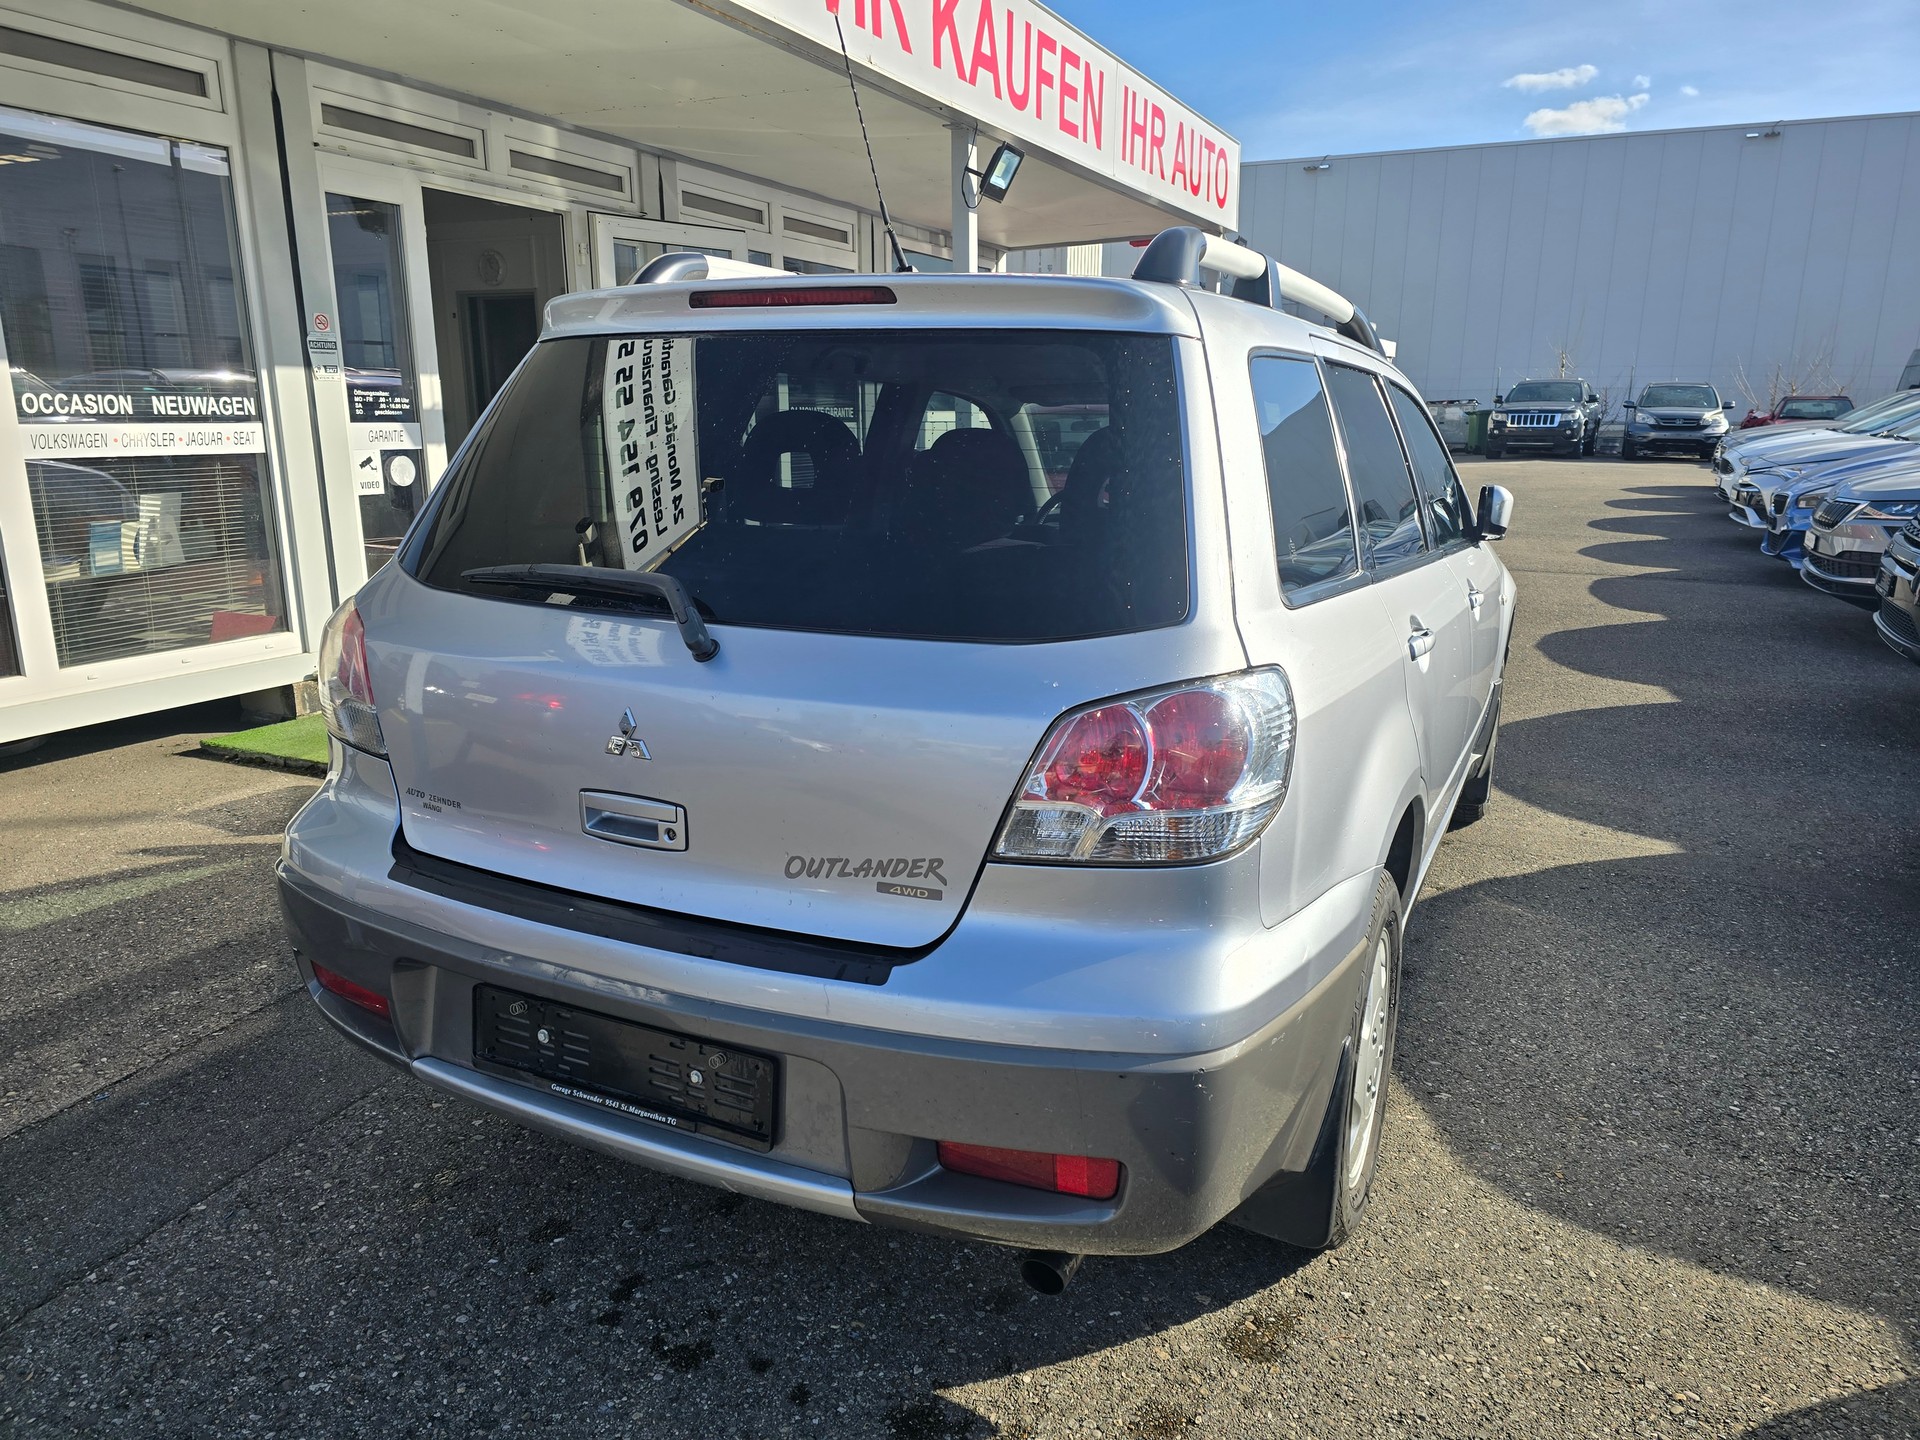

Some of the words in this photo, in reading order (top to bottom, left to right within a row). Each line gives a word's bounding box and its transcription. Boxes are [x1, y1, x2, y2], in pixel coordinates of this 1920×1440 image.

[933, 0, 1104, 151] KAUFEN
[1121, 85, 1165, 181] IHR
[1171, 121, 1229, 209] AUTO
[310, 341, 336, 349] ACHTUNG
[21, 392, 134, 415] OCCASION
[151, 395, 256, 416] NEUWAGEN
[30, 432, 108, 450] VOLKSWAGEN
[121, 432, 176, 448] CHRYSLER
[185, 431, 223, 447] JAGUAR
[233, 431, 256, 445] SEAT
[368, 429, 404, 443] GARANTIE
[360, 481, 380, 489] VIDEO
[406, 787, 425, 799] AUTO
[428, 793, 462, 810] ZEHNDER
[890, 886, 928, 898] 4WD
[551, 1083, 571, 1095] Garage
[572, 1089, 603, 1104] Schwender
[605, 1099, 619, 1109] 9543
[667, 1117, 677, 1126] TG
